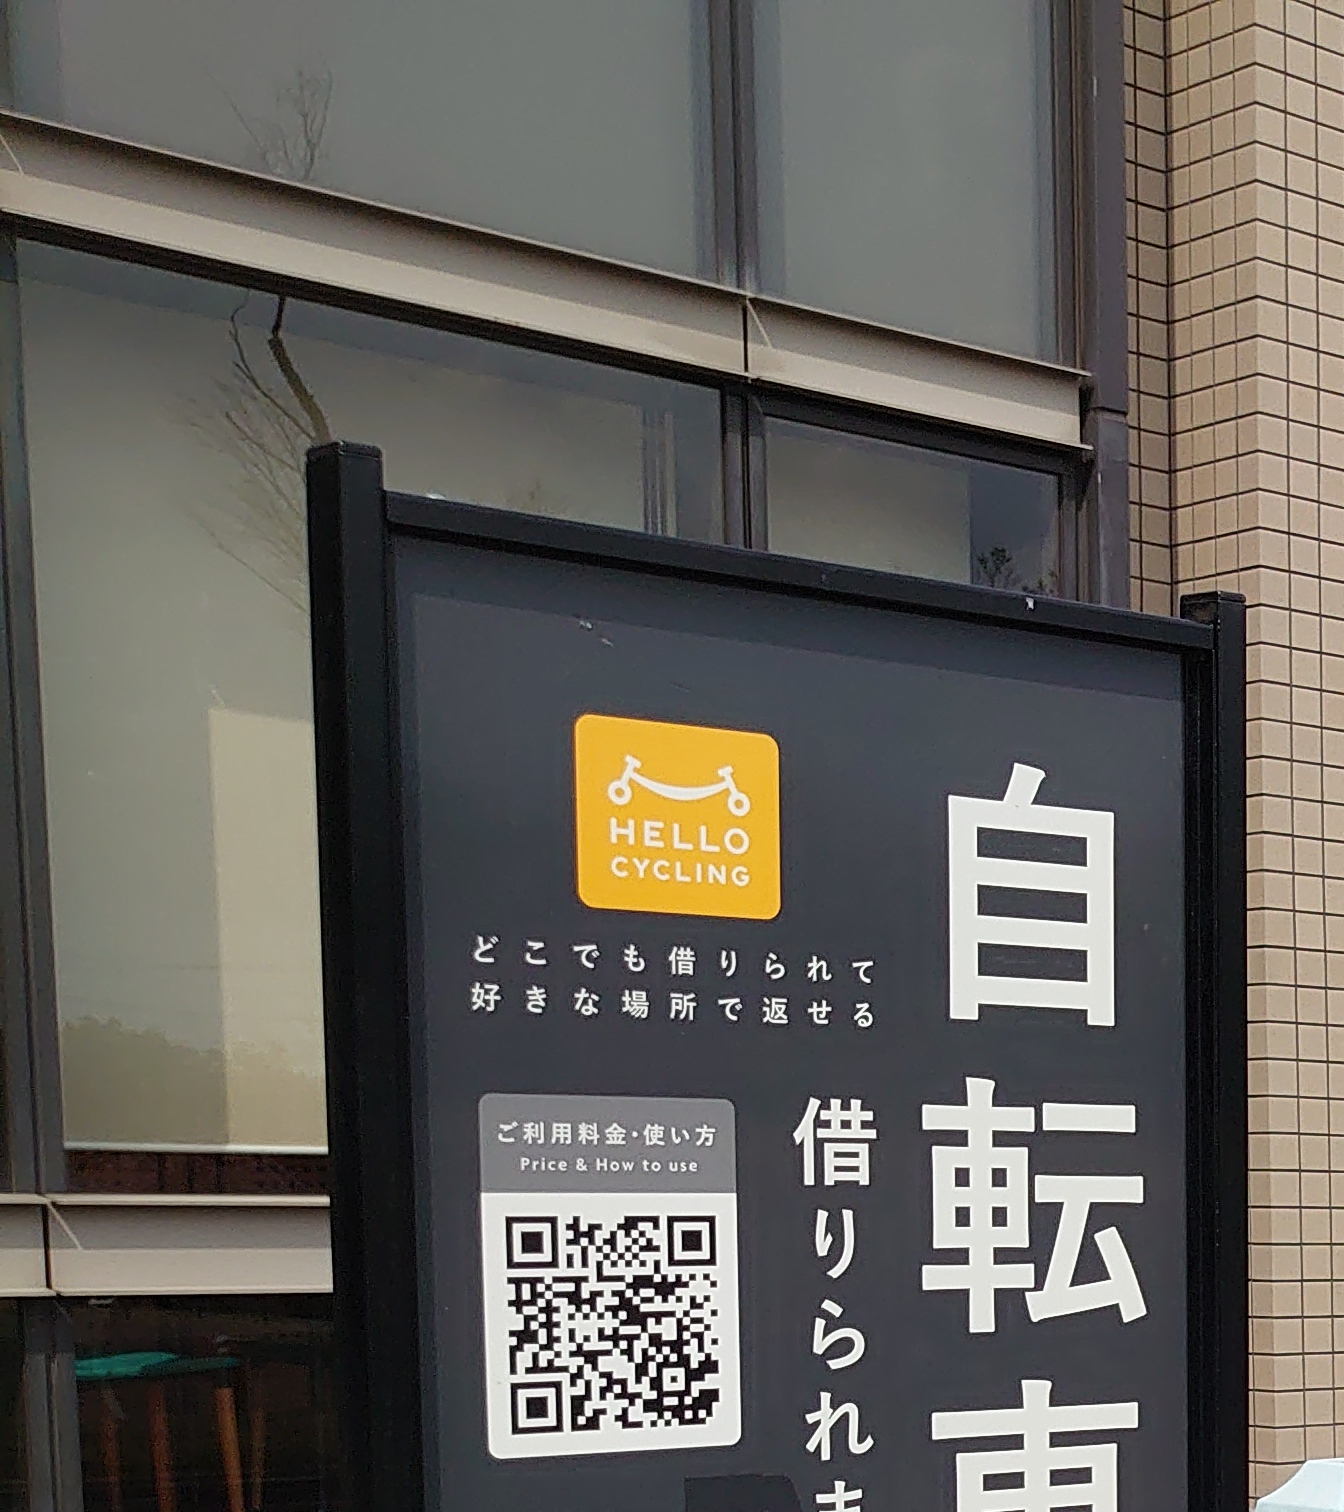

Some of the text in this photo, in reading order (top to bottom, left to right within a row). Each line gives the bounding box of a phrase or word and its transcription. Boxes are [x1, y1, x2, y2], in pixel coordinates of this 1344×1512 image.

[610, 817, 750, 855] HELLO
[611, 856, 750, 887] CYCLING
[472, 935, 875, 984] どこでも借りられて
[471, 982, 875, 1028] 好きな場所で返せる
[520, 1157, 698, 1173] Price & How to use
